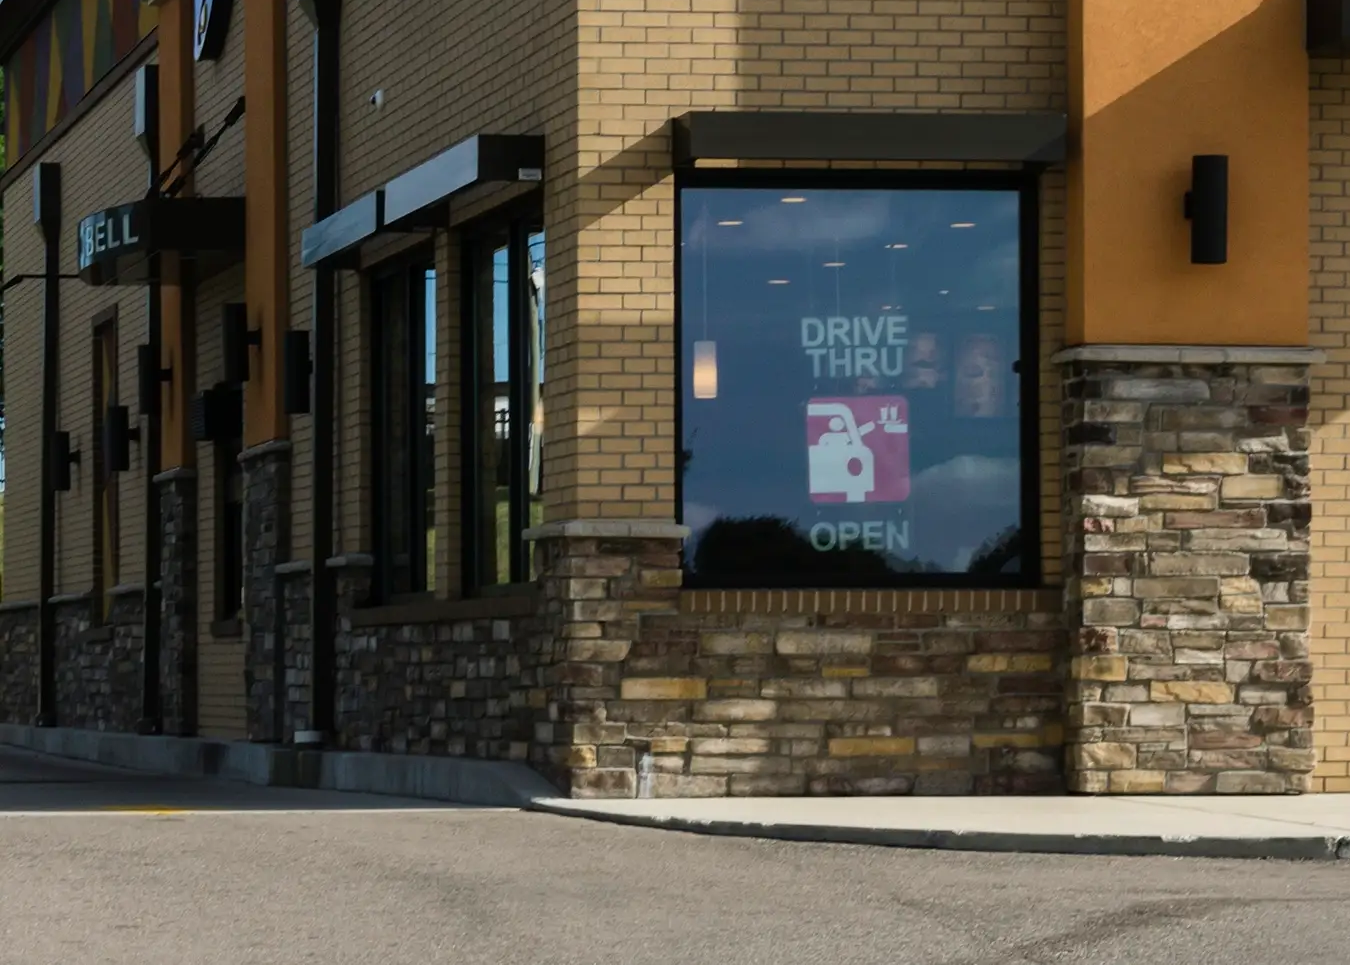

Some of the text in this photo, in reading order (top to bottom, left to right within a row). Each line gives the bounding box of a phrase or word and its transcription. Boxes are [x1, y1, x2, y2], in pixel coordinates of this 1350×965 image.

[85, 214, 139, 257] BELL
[801, 315, 908, 348] DRIVE
[805, 347, 904, 378] THRU
[809, 520, 909, 551] OPEN
